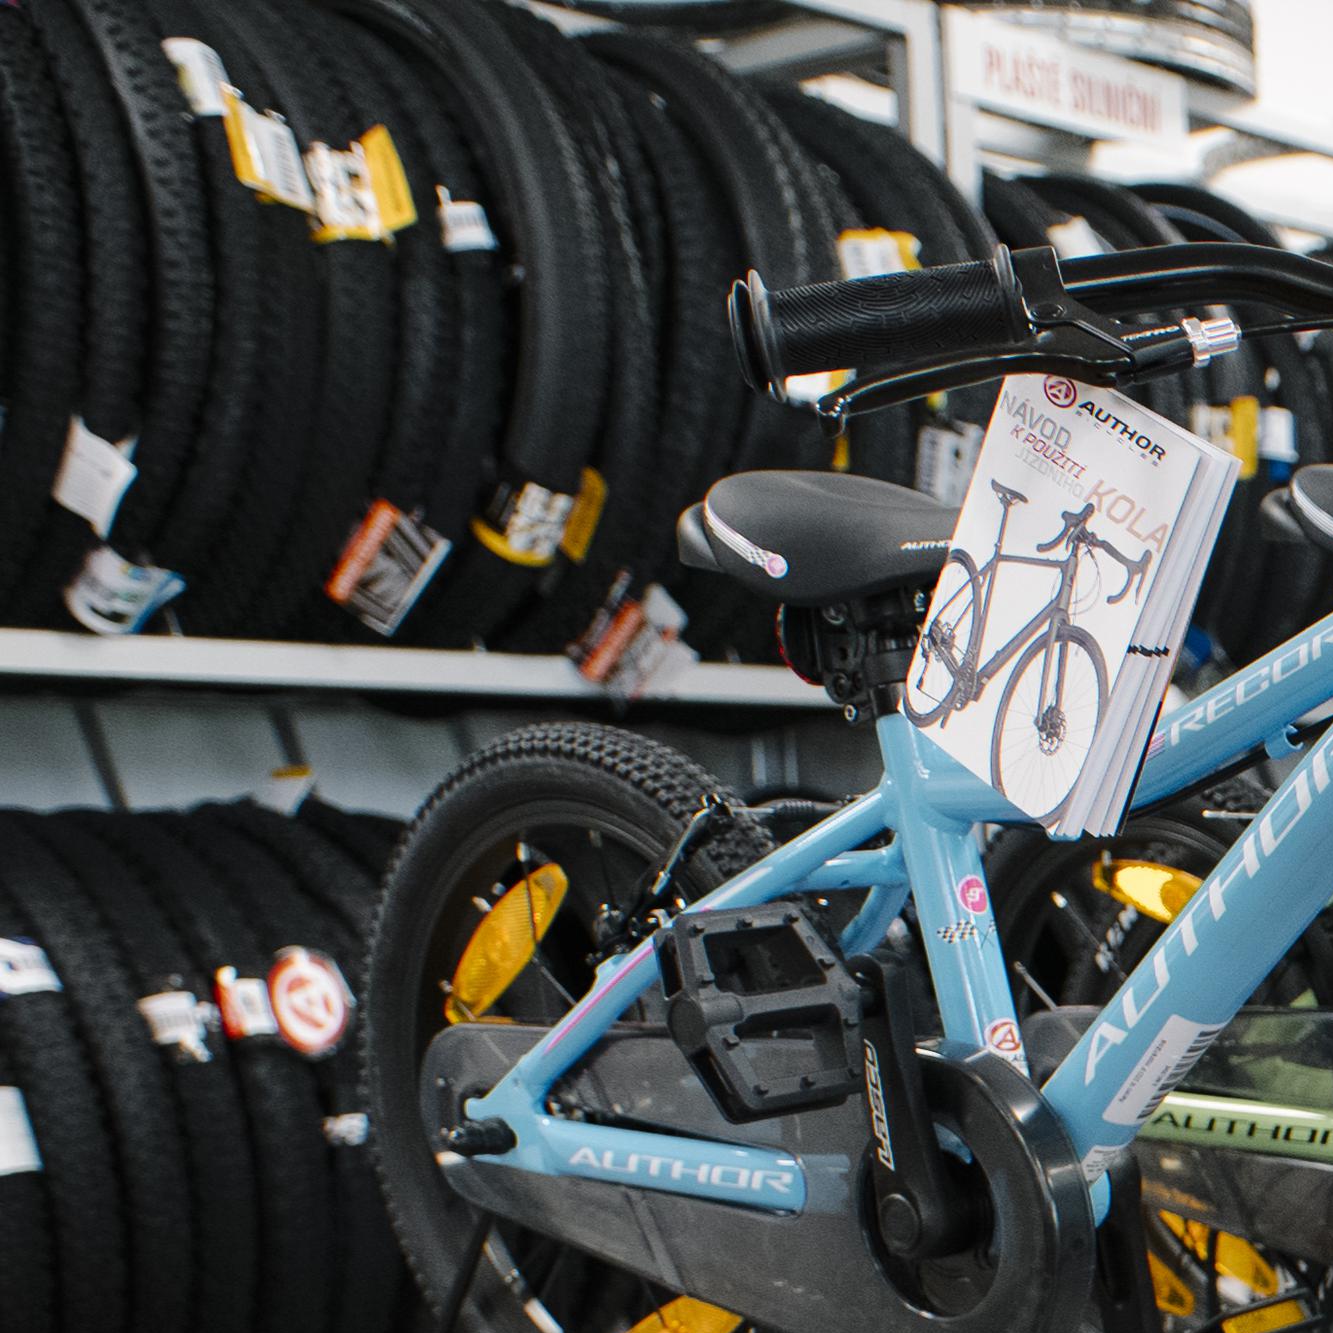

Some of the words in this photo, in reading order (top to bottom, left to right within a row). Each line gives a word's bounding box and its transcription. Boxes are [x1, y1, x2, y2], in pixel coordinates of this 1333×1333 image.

[999, 390, 1072, 450] NÁVOD
[1010, 423, 1021, 440] K
[1077, 399, 1168, 461] AUTHOR
[1082, 479, 1169, 551] KOLA
[568, 1146, 795, 1195] AUTHOR
